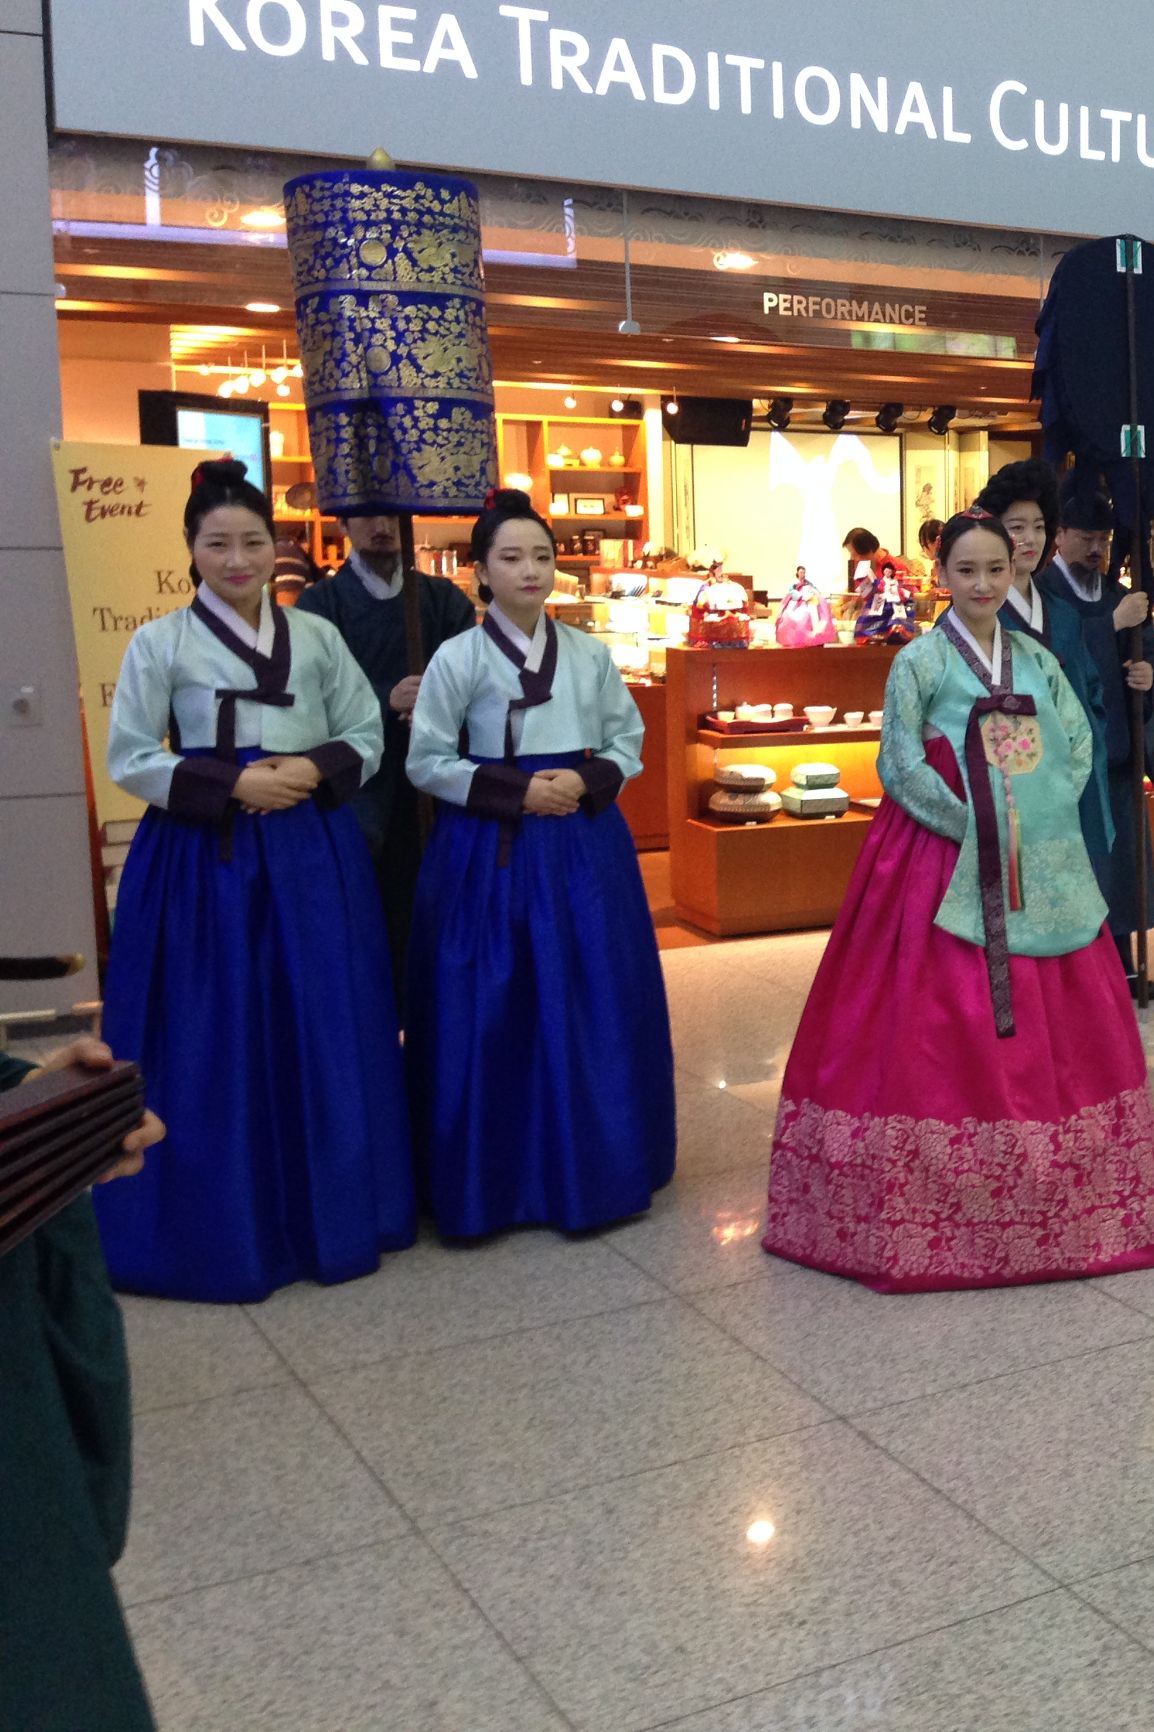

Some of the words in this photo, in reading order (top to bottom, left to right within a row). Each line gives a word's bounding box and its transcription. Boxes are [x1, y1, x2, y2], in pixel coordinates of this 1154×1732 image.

[188, 0, 479, 79] KOREA
[498, 4, 973, 145] TRADITIONAL
[763, 291, 928, 326] PERFORMANCE
[68, 466, 127, 495] Free
[83, 499, 153, 523] Event
[156, 569, 192, 596] Ko
[92, 605, 162, 633] Trad
